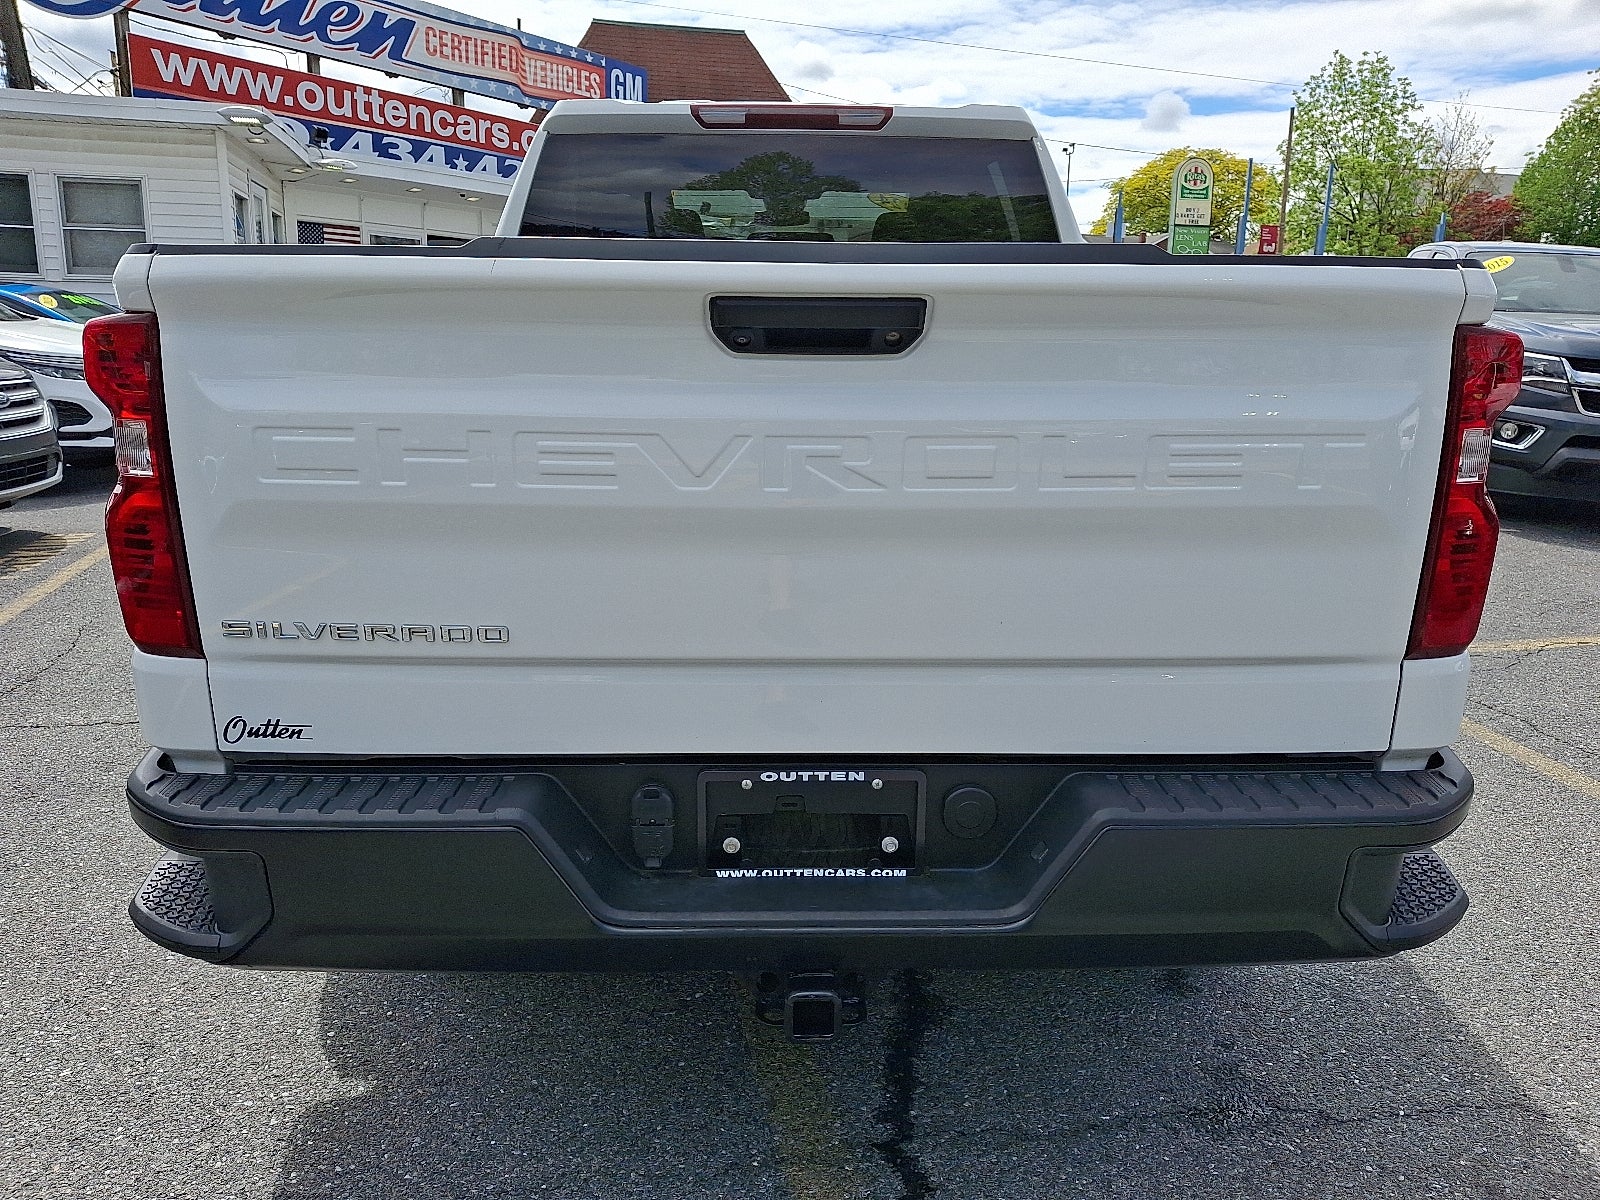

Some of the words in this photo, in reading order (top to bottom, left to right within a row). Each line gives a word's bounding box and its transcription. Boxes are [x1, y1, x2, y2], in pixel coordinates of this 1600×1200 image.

[424, 26, 520, 74] CERTIFIED
[524, 56, 601, 99] VEHICLES
[610, 68, 644, 103] GM
[253, 426, 1367, 493] CHEVROLET
[221, 619, 510, 643] SILVERADO
[222, 715, 313, 744] Outten
[760, 771, 865, 783] OUTTEN
